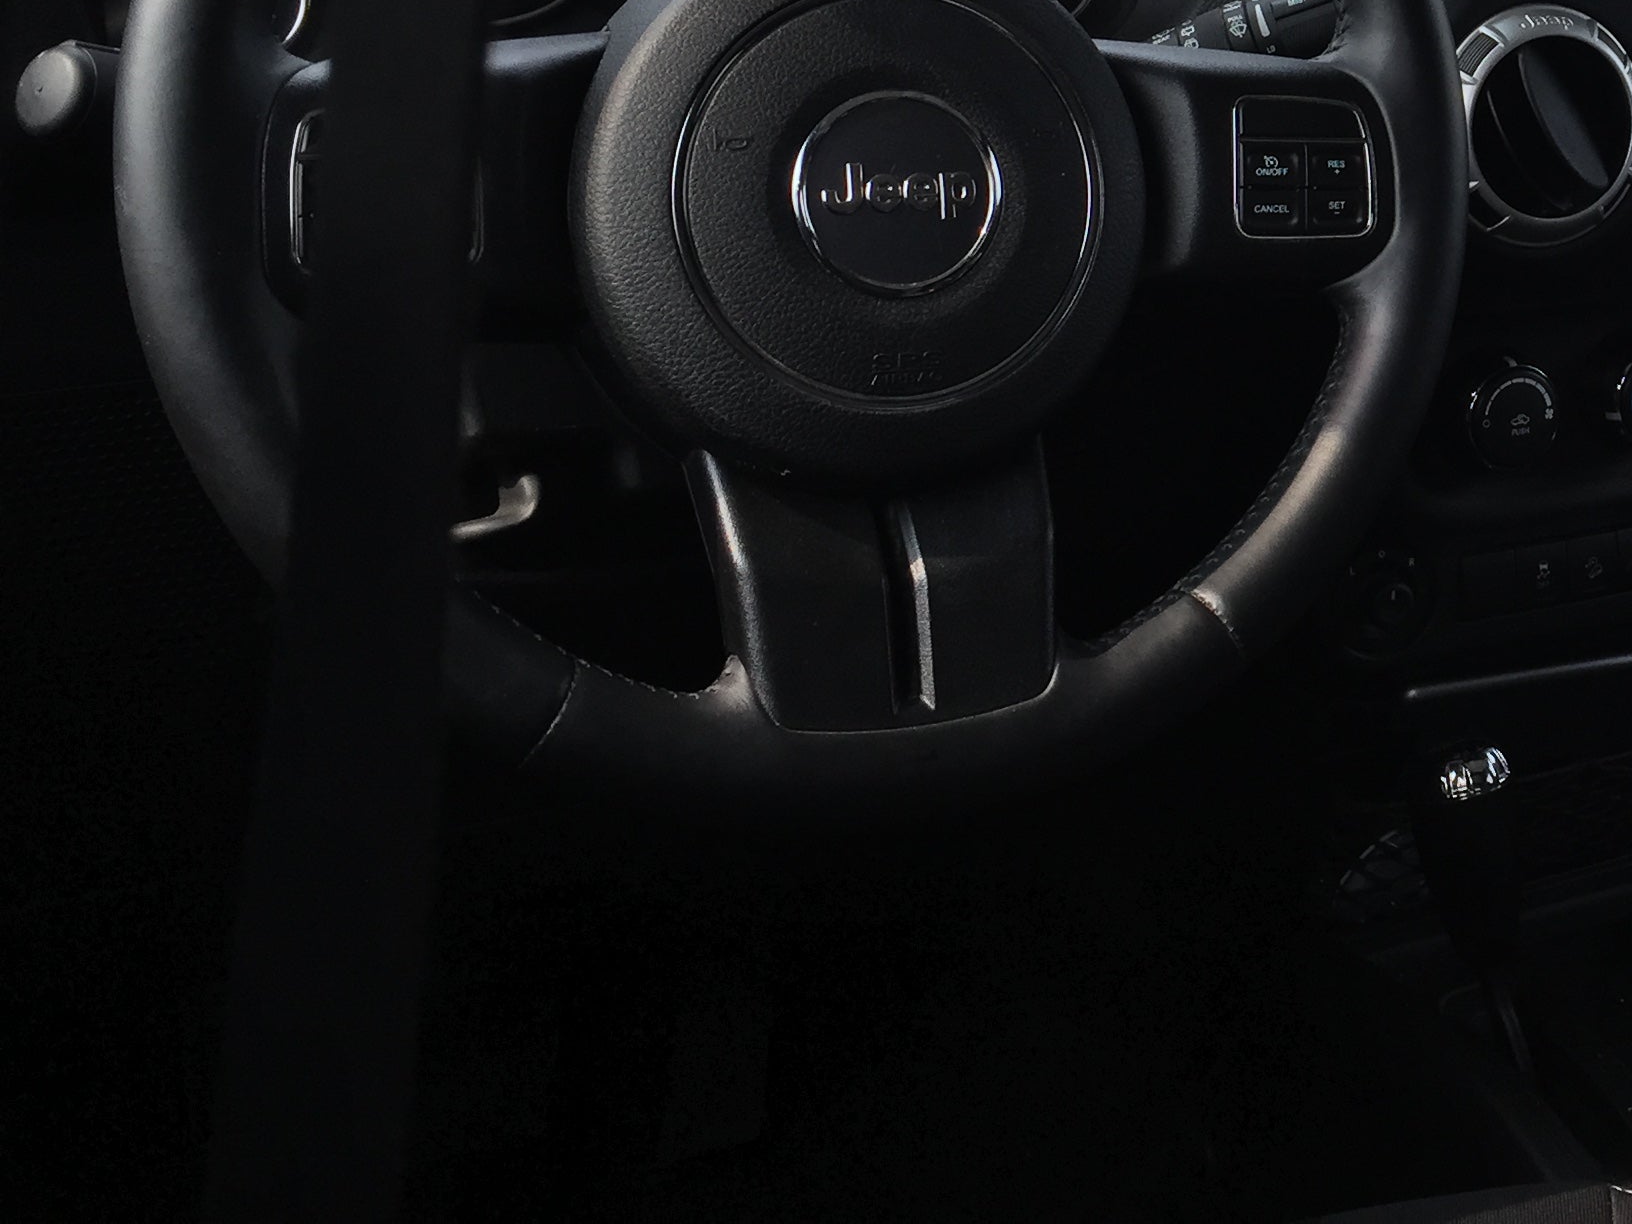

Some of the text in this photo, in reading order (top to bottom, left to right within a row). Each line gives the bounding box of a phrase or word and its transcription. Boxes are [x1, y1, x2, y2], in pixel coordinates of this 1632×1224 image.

[1327, 159, 1346, 169] RES
[1255, 167, 1289, 177] ON/OFF
[820, 161, 977, 220] Jeep
[1253, 204, 1290, 214] CANCEL
[1328, 200, 1346, 210] SET
[1511, 426, 1531, 437] PUSH
